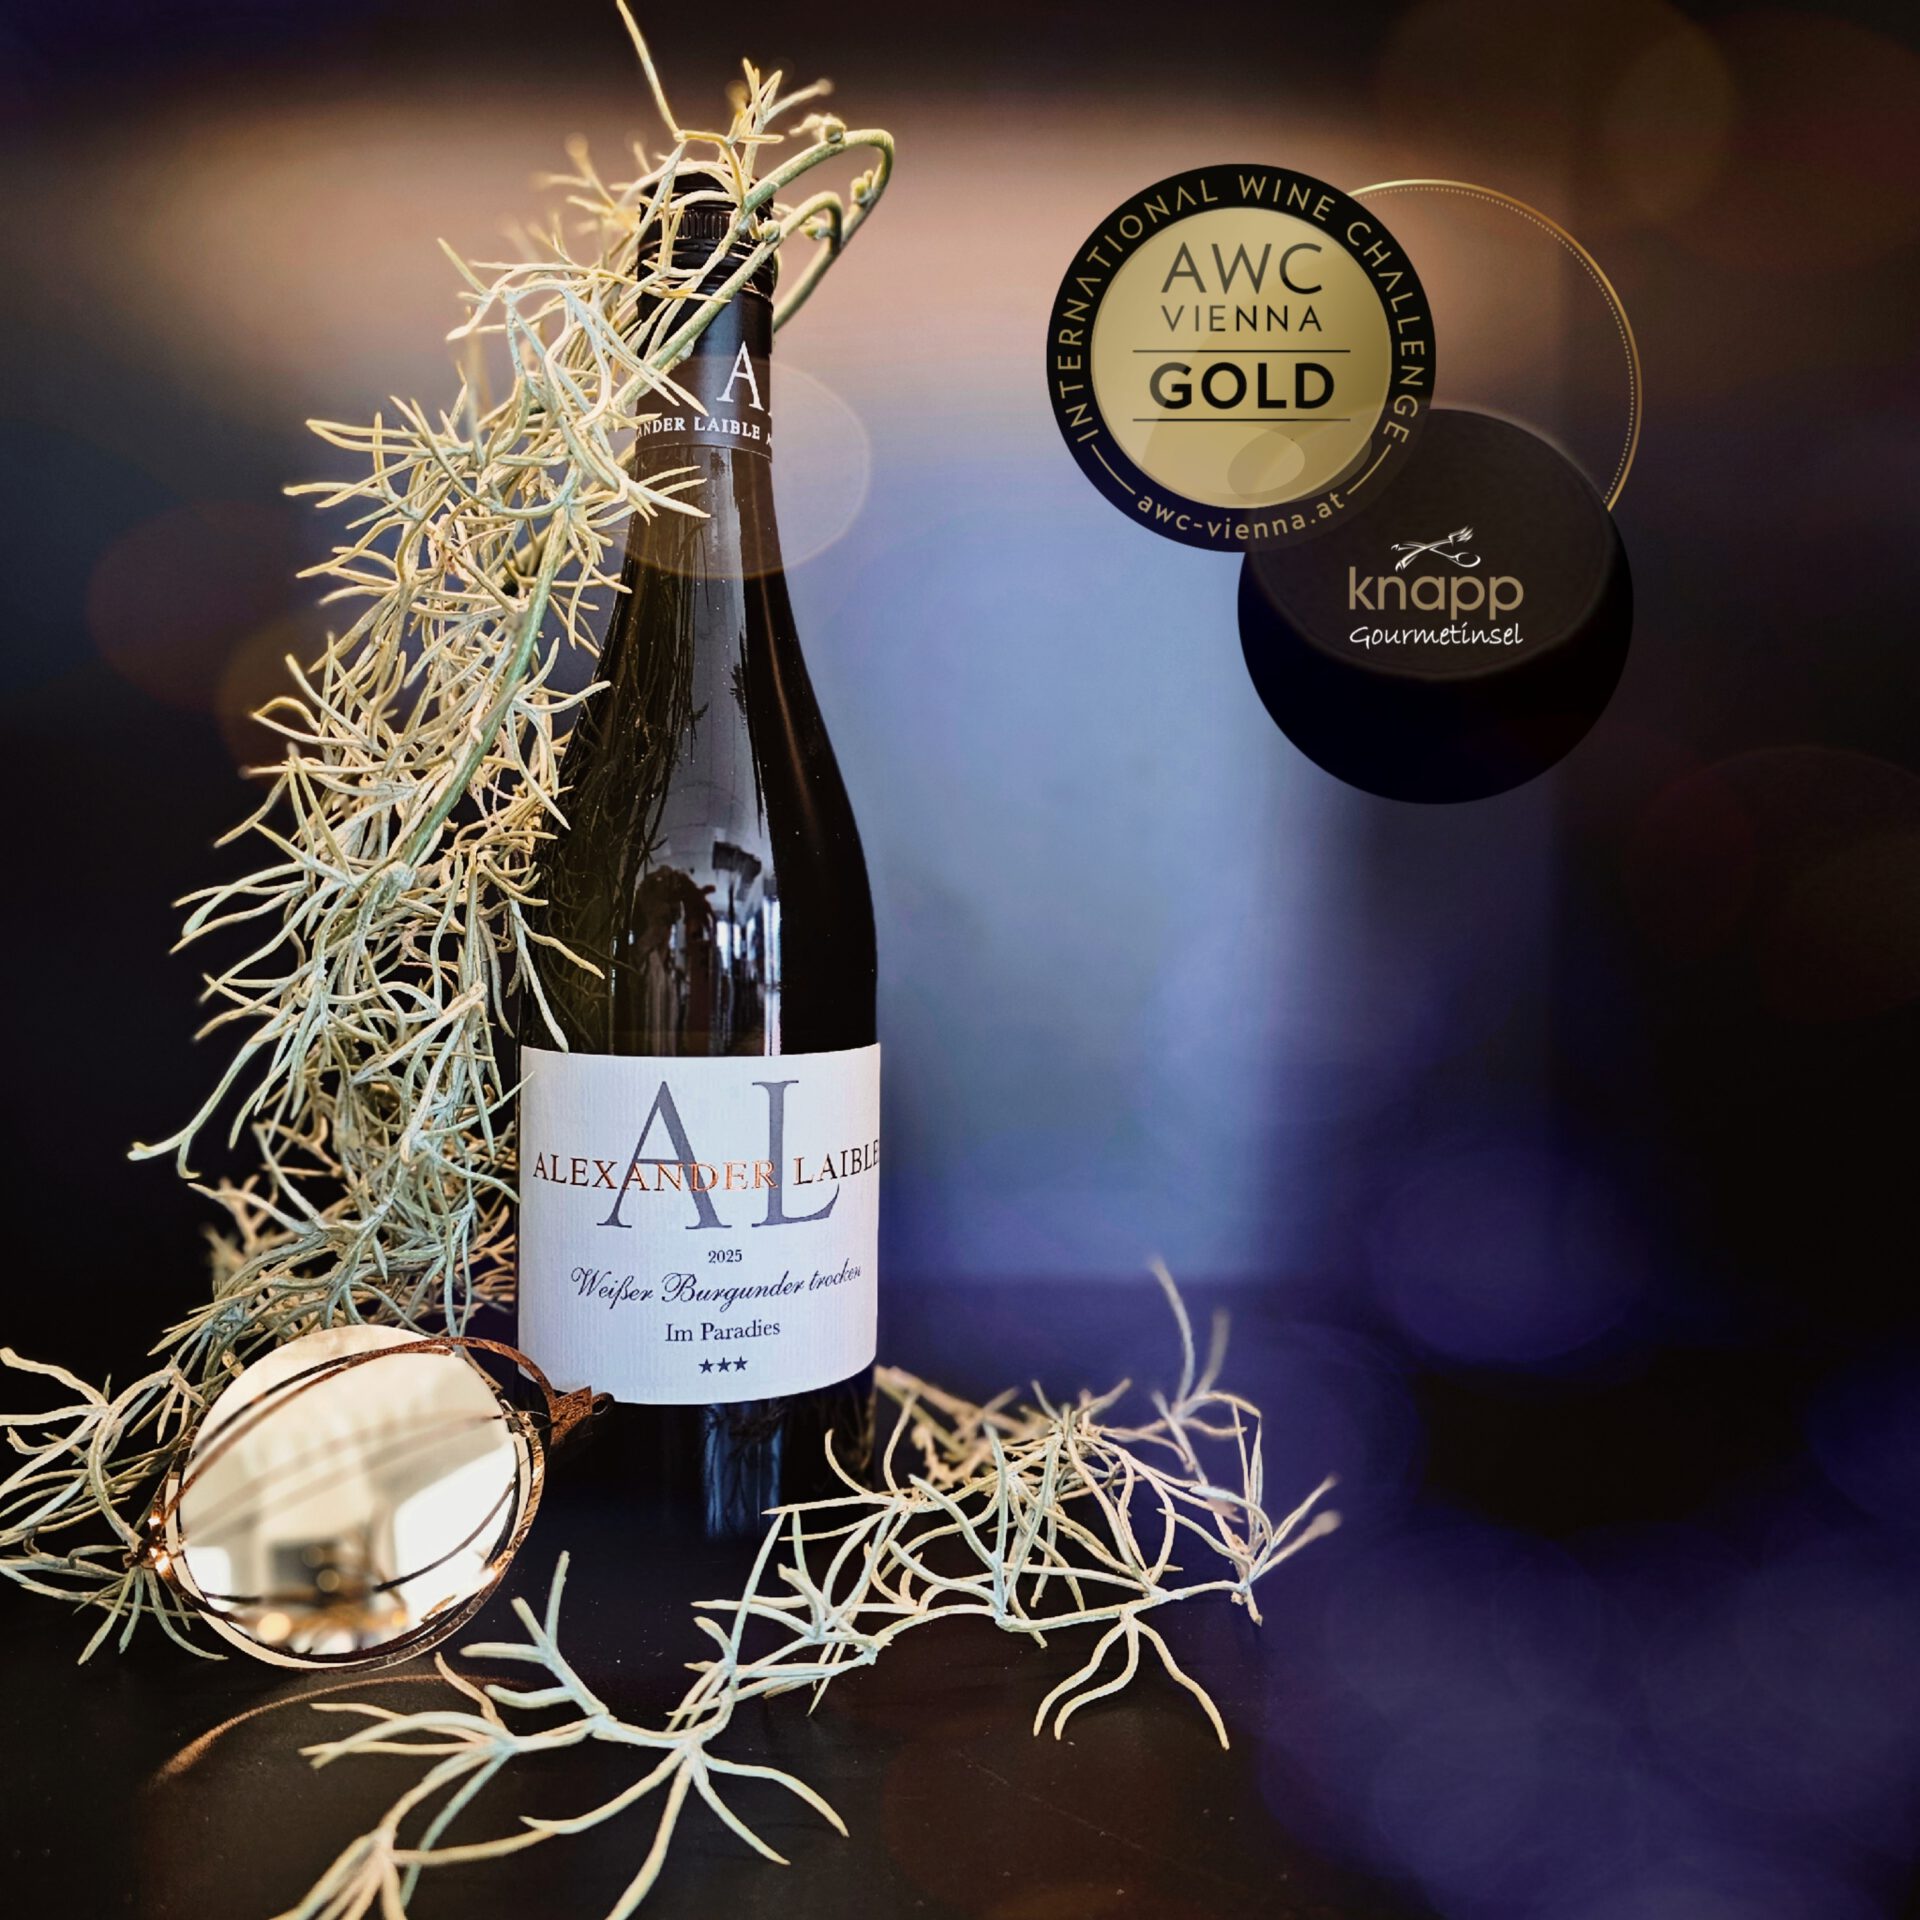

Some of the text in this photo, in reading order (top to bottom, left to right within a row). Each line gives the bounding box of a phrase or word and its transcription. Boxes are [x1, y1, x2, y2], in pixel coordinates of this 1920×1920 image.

[716, 340, 765, 411] A
[694, 416, 760, 440] LAIBLE
[532, 1139, 879, 1192] ALEXANDER LAIBLE
[707, 1248, 743, 1264] 2025
[570, 1257, 862, 1313] Weißer Burgunder trocken
[664, 1318, 781, 1342] Im Paradies
